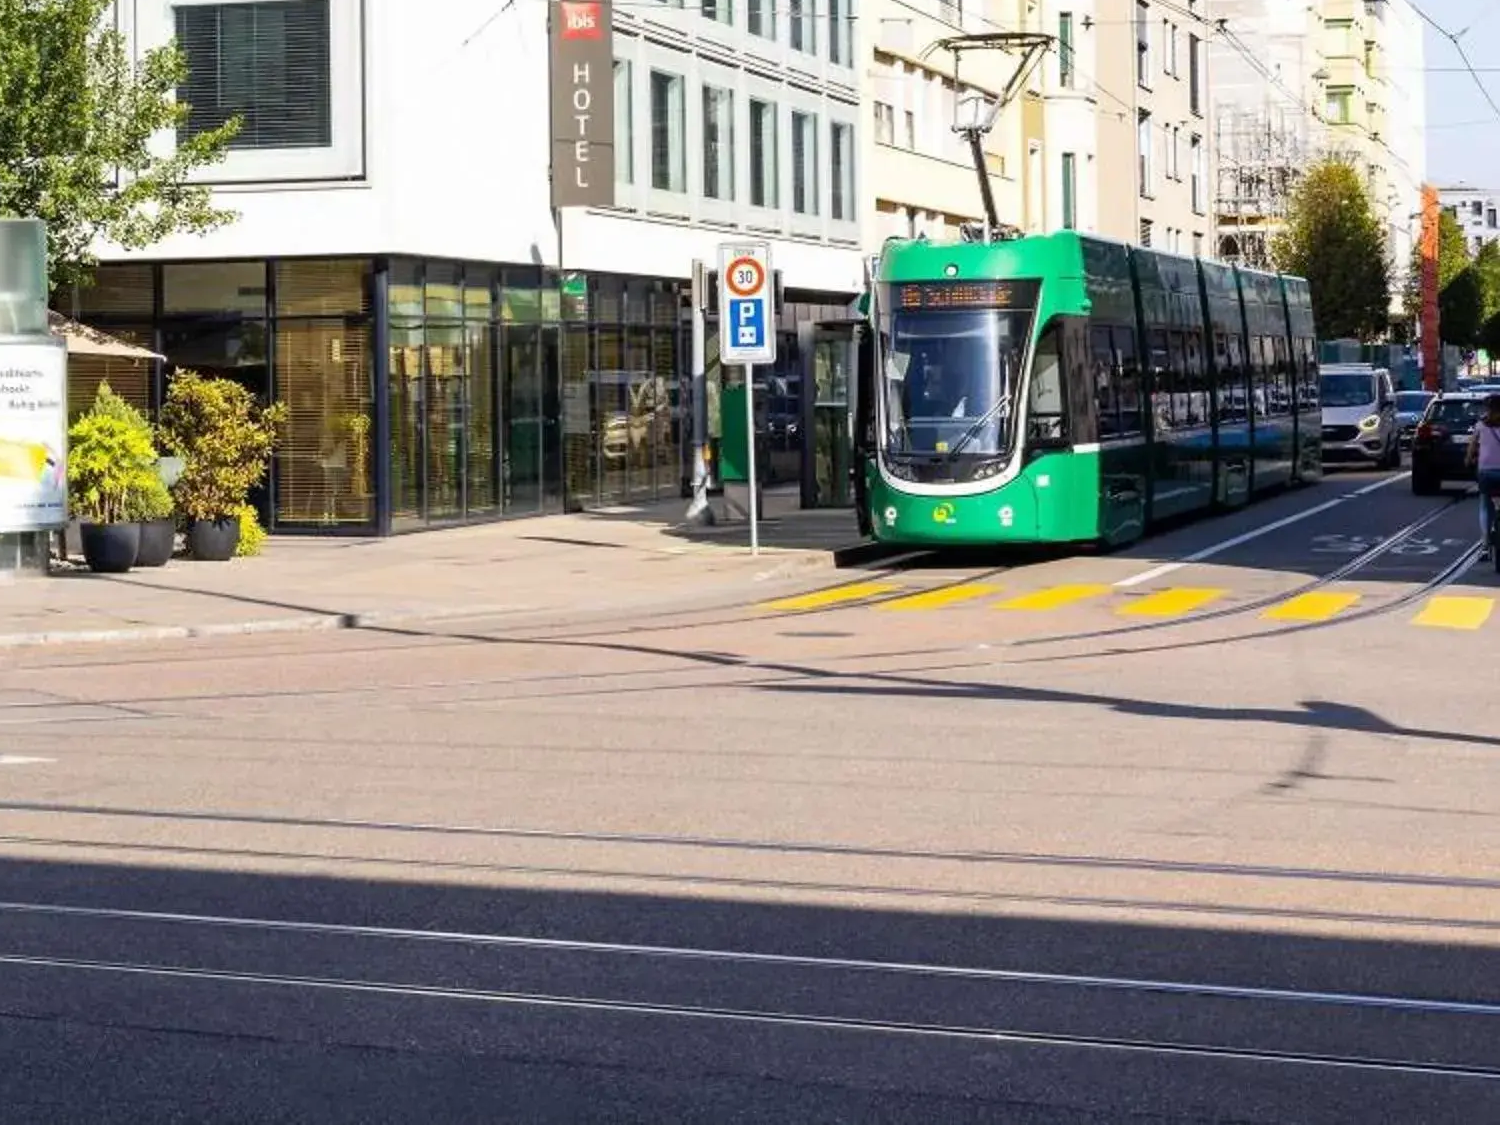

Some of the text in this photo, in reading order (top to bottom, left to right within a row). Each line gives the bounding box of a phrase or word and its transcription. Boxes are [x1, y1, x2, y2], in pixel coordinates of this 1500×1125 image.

[567, 12, 596, 29] ibis
[572, 62, 591, 188] HOTEL
[738, 270, 753, 284] 30
[740, 302, 755, 326] P
